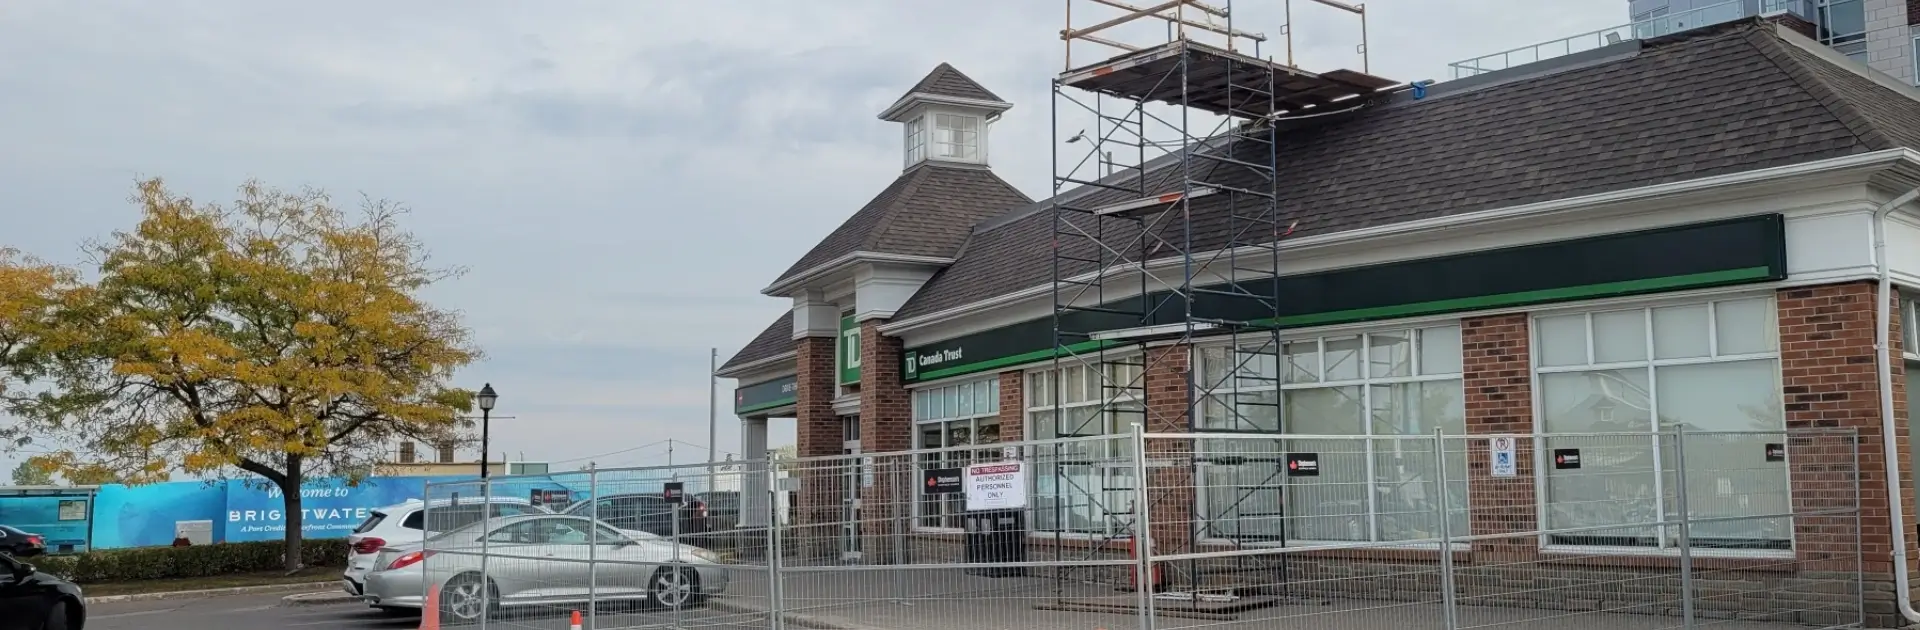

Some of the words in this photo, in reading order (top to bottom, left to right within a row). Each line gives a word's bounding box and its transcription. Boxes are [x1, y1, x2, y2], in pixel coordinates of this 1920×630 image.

[843, 327, 861, 369] TD
[906, 357, 916, 373] TD
[919, 350, 943, 366] Canada
[943, 346, 963, 362] Trust
[981, 465, 1018, 473] TRESPASSING
[976, 474, 1015, 482] AUTHORIZED
[334, 487, 349, 497] to
[976, 483, 1013, 491] PERSONNEL
[229, 507, 372, 522] BRIGTWATE
